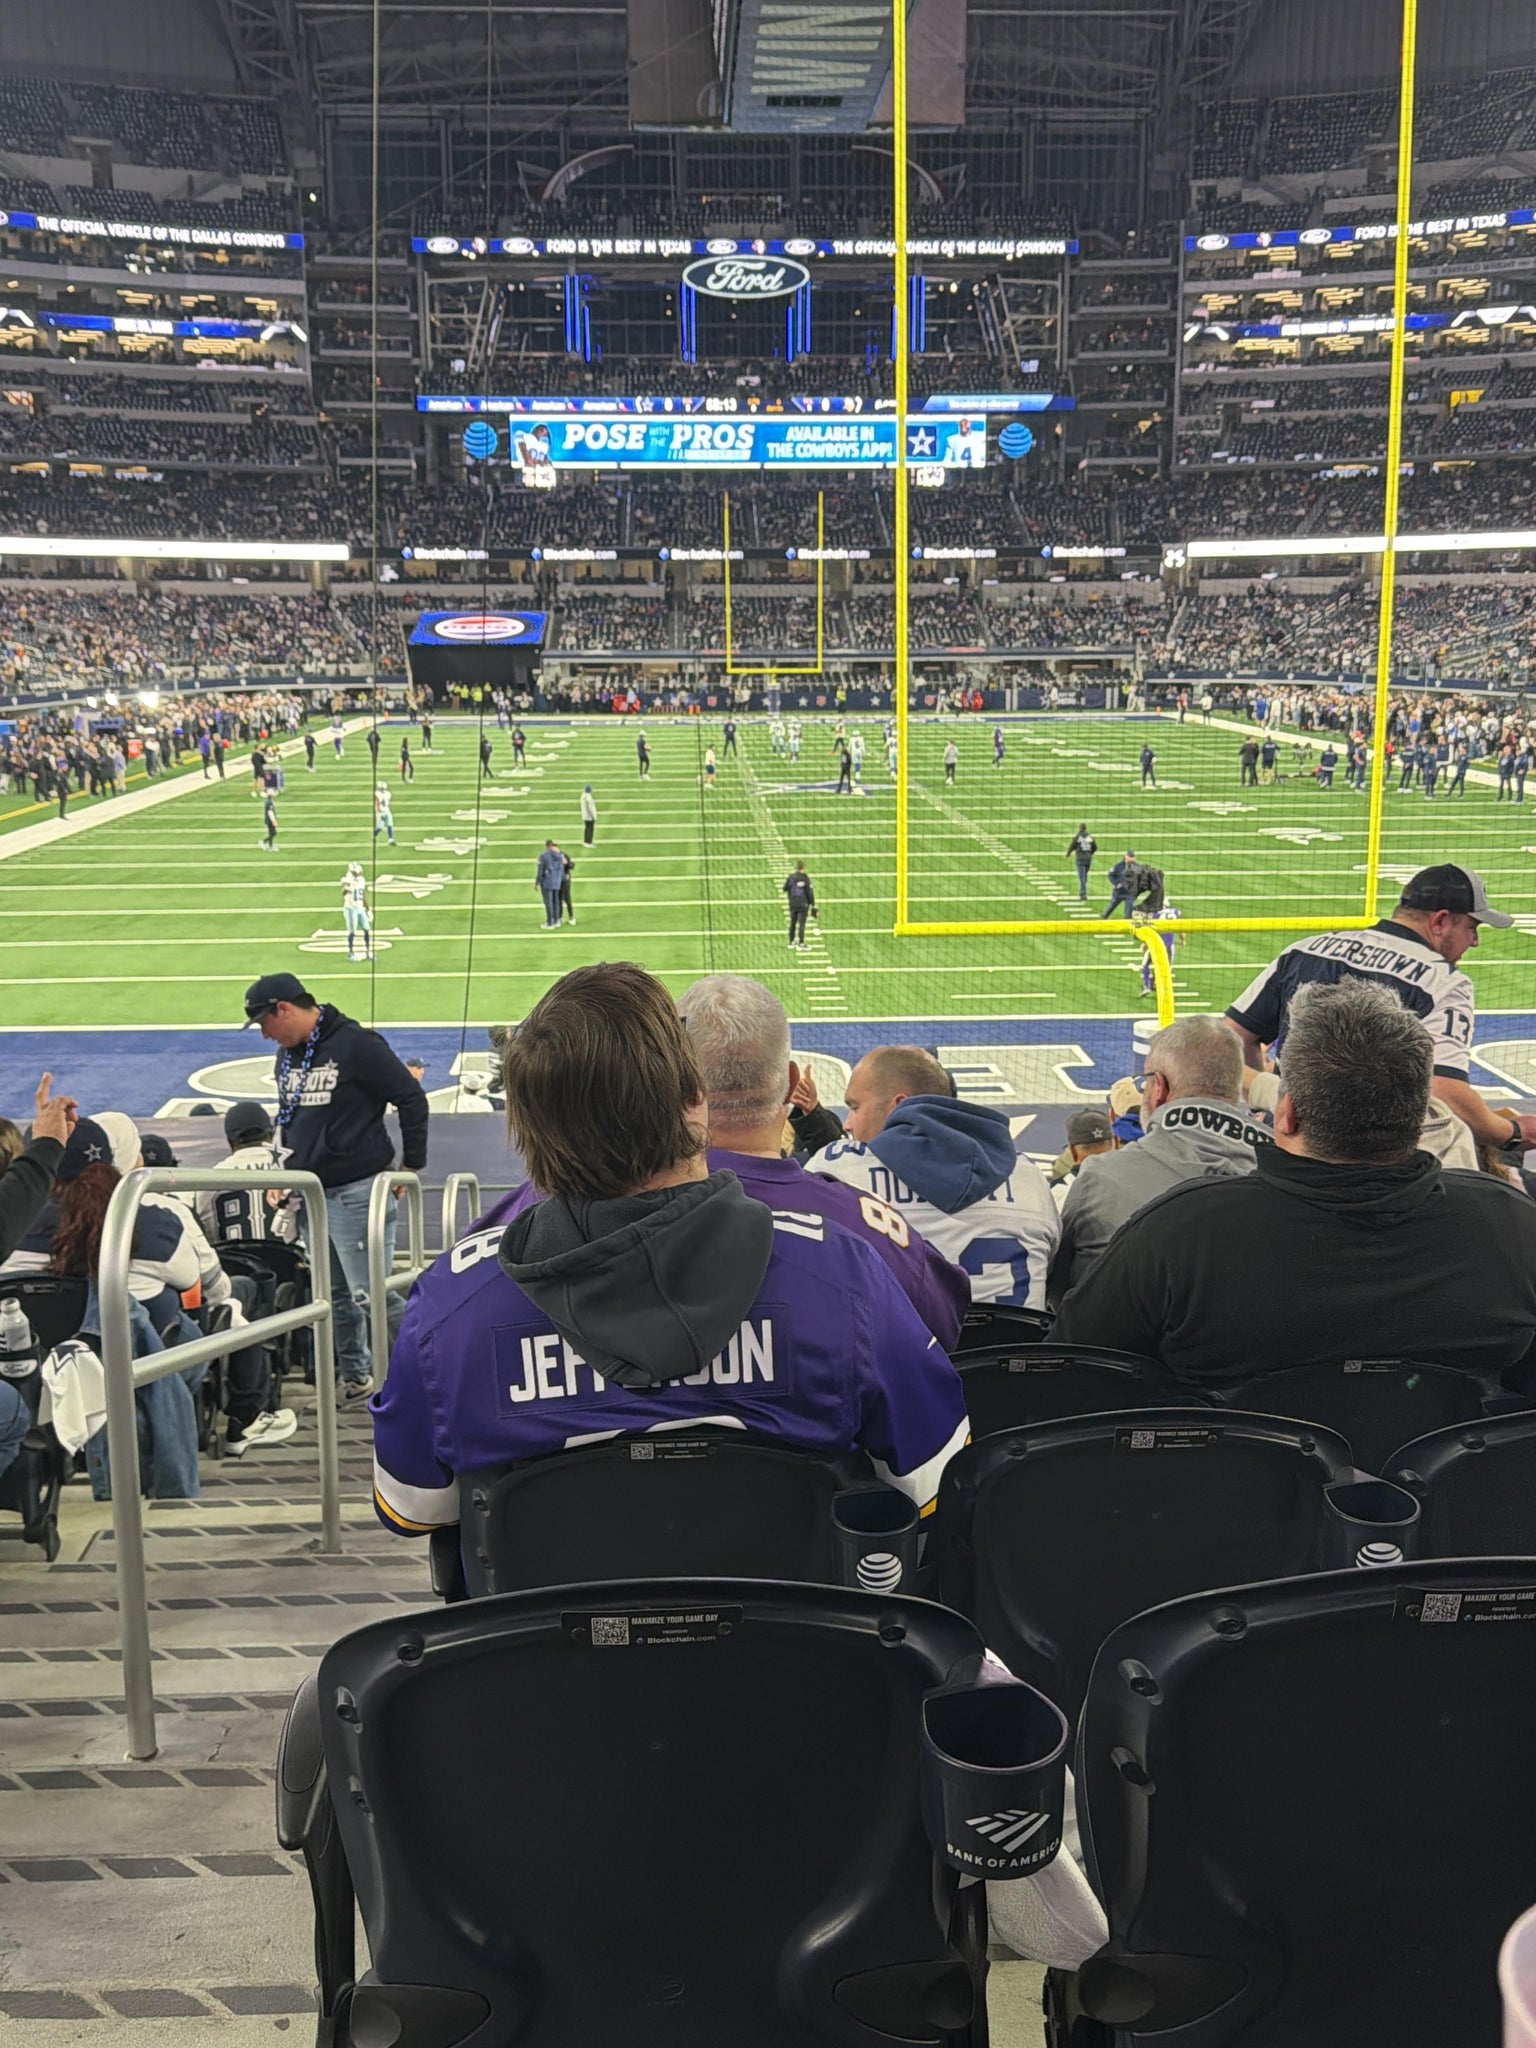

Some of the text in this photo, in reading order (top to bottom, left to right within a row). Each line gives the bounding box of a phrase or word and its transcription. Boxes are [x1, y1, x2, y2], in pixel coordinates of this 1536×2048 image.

[38, 216, 286, 249] THE OFFICIAL VEHICLE OF THE DALLAS COWBOYS
[1355, 226, 1386, 240] FORD
[1426, 218, 1454, 234] BEST
[1455, 217, 1470, 231] IN
[1471, 213, 1507, 229] TEXAS
[547, 239, 691, 254] FORD IS THE BEST IN TEXAS
[833, 240, 853, 255] THE
[905, 240, 939, 254] EHICLE
[957, 240, 976, 254] THE
[979, 240, 1015, 254] DALLAS
[1016, 240, 1066, 255] COWBOYS
[706, 260, 786, 291] Ford
[562, 423, 647, 450] POSE
[669, 423, 756, 449] PROS
[785, 426, 875, 441] AVAILABLE IN
[766, 442, 794, 458] THE
[795, 442, 860, 458] COWBOYS
[860, 442, 893, 458] APP!
[1308, 936, 1431, 982] OVERSHOWN
[1441, 1008, 1470, 1045] 13
[631, 1613, 719, 1625] MAXIMIZE YOUR GAME DAY
[647, 1635, 716, 1644] Blockchain.com
[947, 1837, 1060, 1868] BANK OF AMERICA
